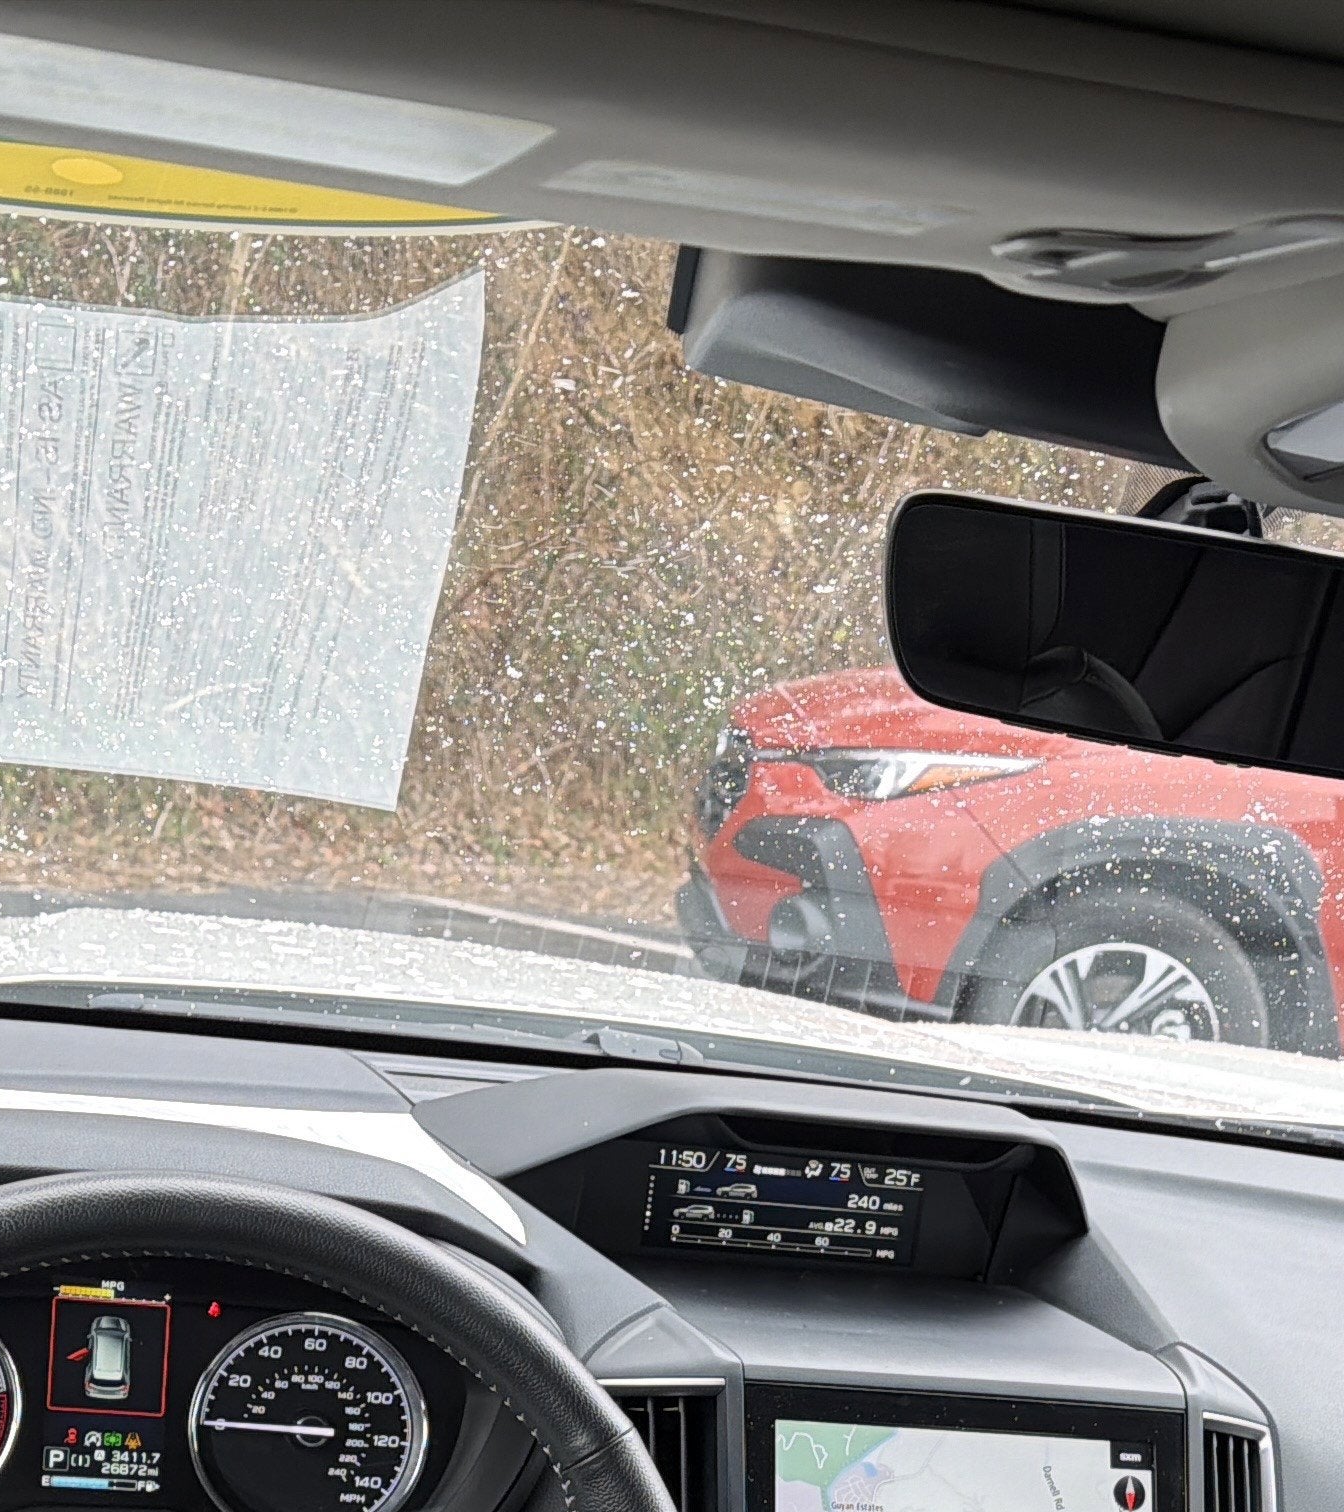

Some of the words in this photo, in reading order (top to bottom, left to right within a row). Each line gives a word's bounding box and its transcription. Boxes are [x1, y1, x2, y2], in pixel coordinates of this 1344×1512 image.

[658, 1148, 706, 1169] 11:50
[725, 1153, 747, 1170] 75
[830, 1162, 851, 1178] 75
[847, 1193, 880, 1210] 240
[717, 1227, 732, 1239] 20
[833, 1218, 876, 1235] 22.9
[879, 1227, 899, 1237] MPG
[766, 1232, 781, 1243] 40
[876, 1248, 895, 1259] MPG
[101, 1279, 125, 1291] MPG
[304, 1338, 327, 1351] 60
[258, 1346, 283, 1359] 40
[345, 1357, 368, 1370] 80
[228, 1375, 251, 1388] 20
[308, 1375, 325, 1384] 100
[325, 1381, 341, 1389] 120
[337, 1391, 354, 1400] 140
[366, 1391, 393, 1405] 100
[372, 1434, 400, 1448] 120
[48, 1449, 65, 1469] P
[111, 1449, 161, 1464] 3411.7
[354, 1476, 382, 1490] 140
[1042, 1465, 1061, 1497] Darnell
[339, 1493, 366, 1504] MPH
